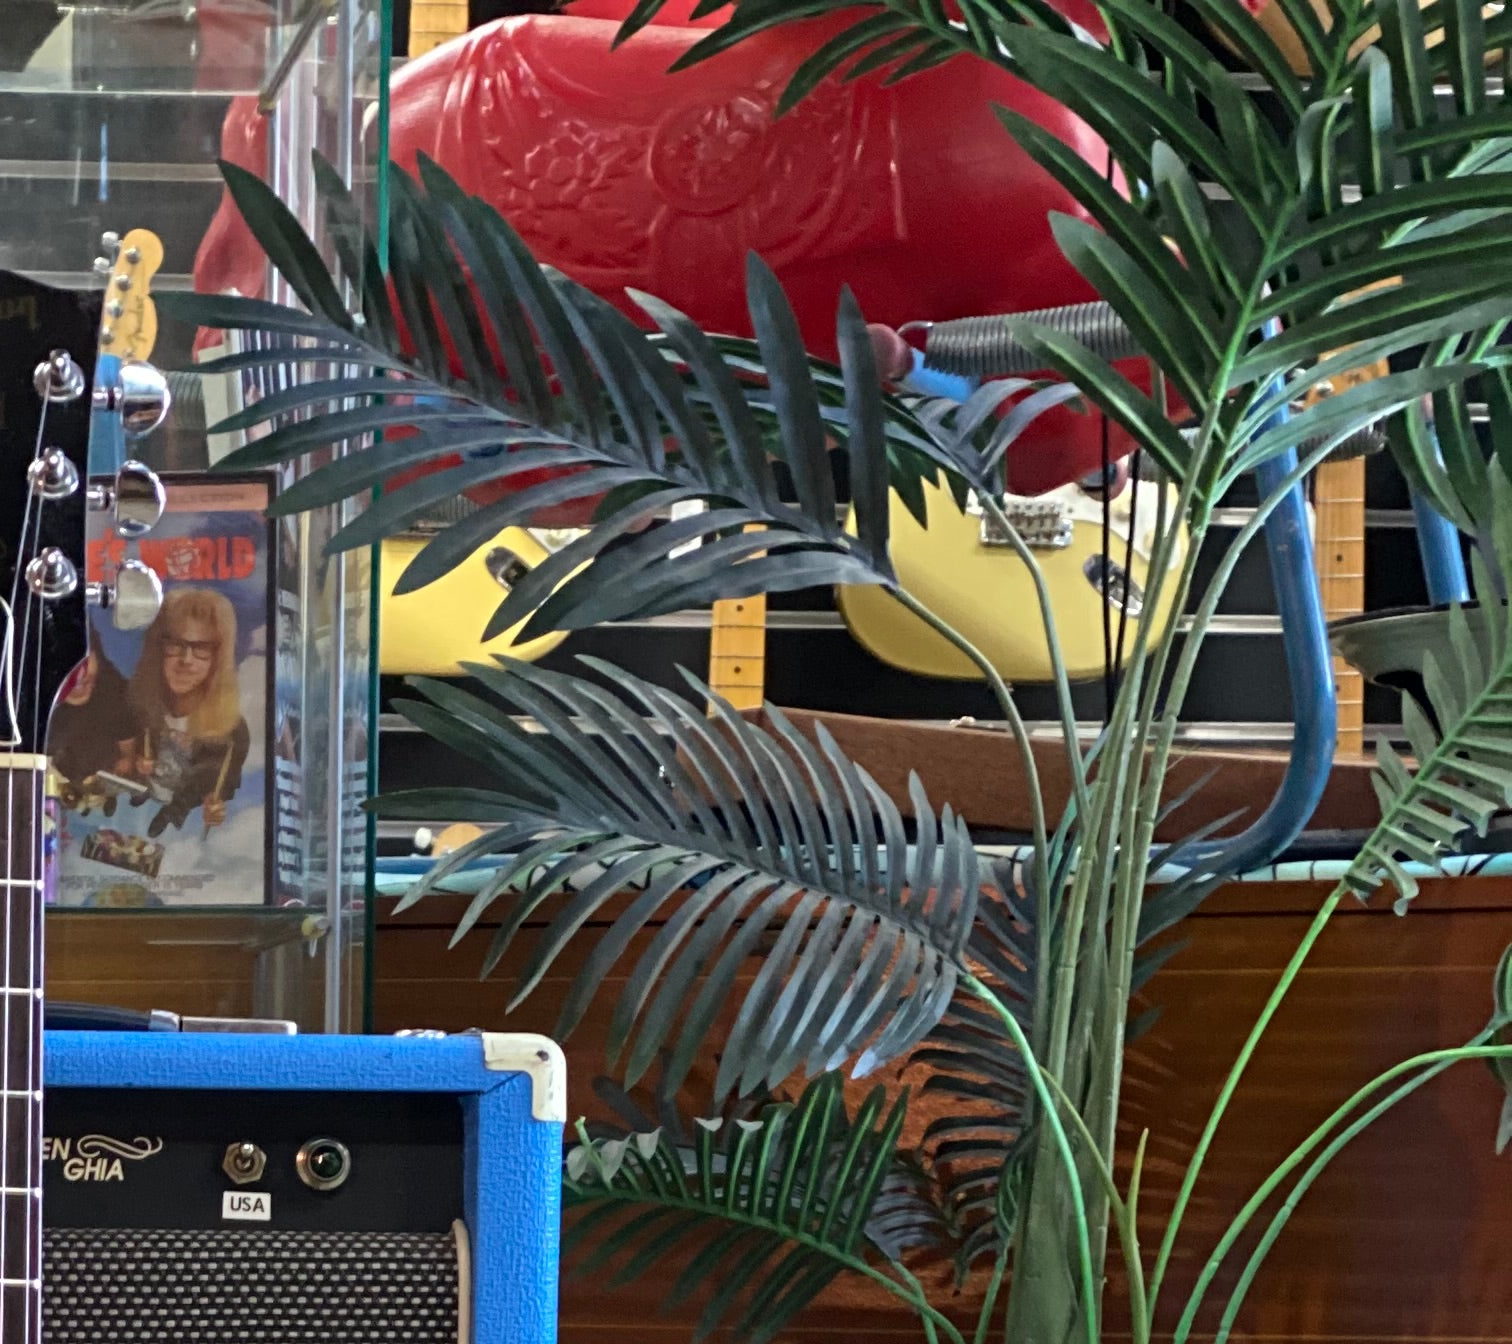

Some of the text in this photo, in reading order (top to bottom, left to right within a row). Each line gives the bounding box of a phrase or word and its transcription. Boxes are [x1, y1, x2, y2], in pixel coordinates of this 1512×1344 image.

[86, 528, 128, 582] E'S
[63, 1158, 125, 1182] GHIA
[229, 1195, 265, 1213] USA
